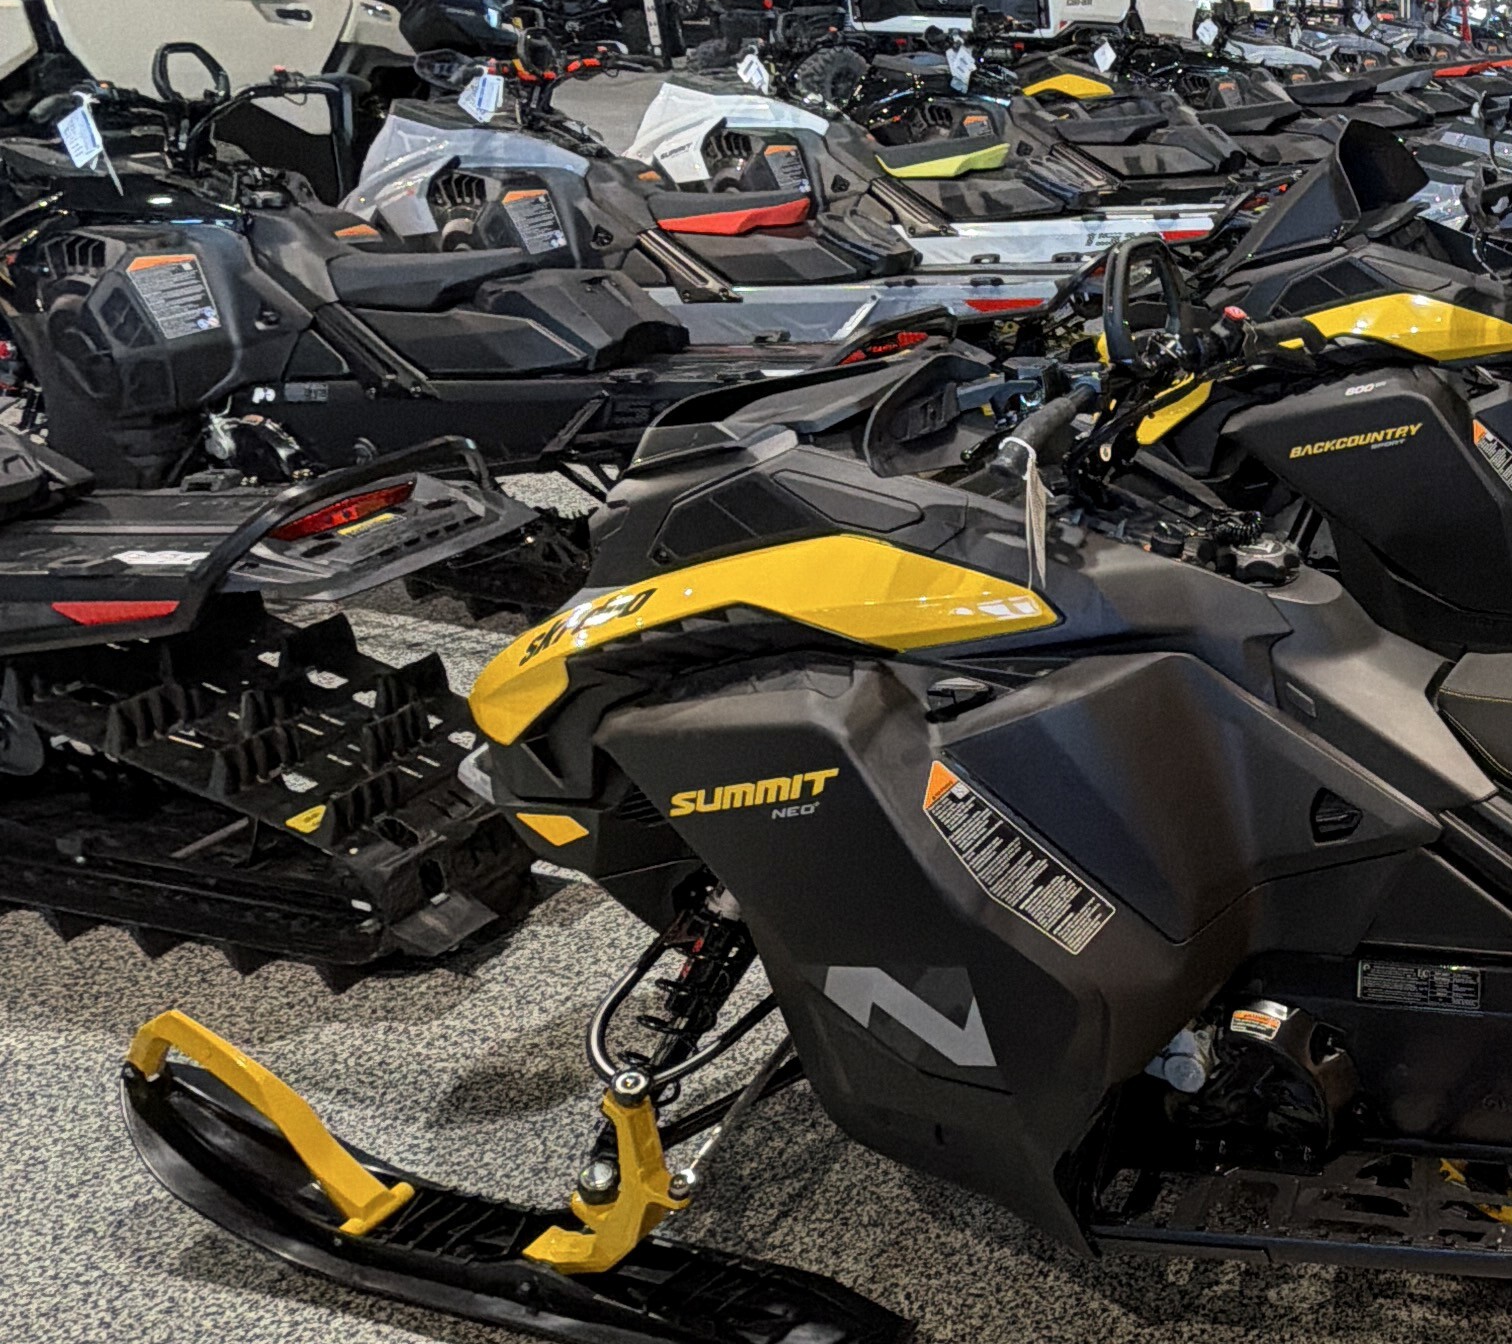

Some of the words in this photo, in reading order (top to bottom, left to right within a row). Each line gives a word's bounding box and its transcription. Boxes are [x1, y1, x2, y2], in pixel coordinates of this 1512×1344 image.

[1344, 383, 1375, 396] 600
[1289, 422, 1424, 459] BACKCOUNTRY
[1371, 438, 1406, 451] SPORT
[669, 767, 840, 817] SUMMIT
